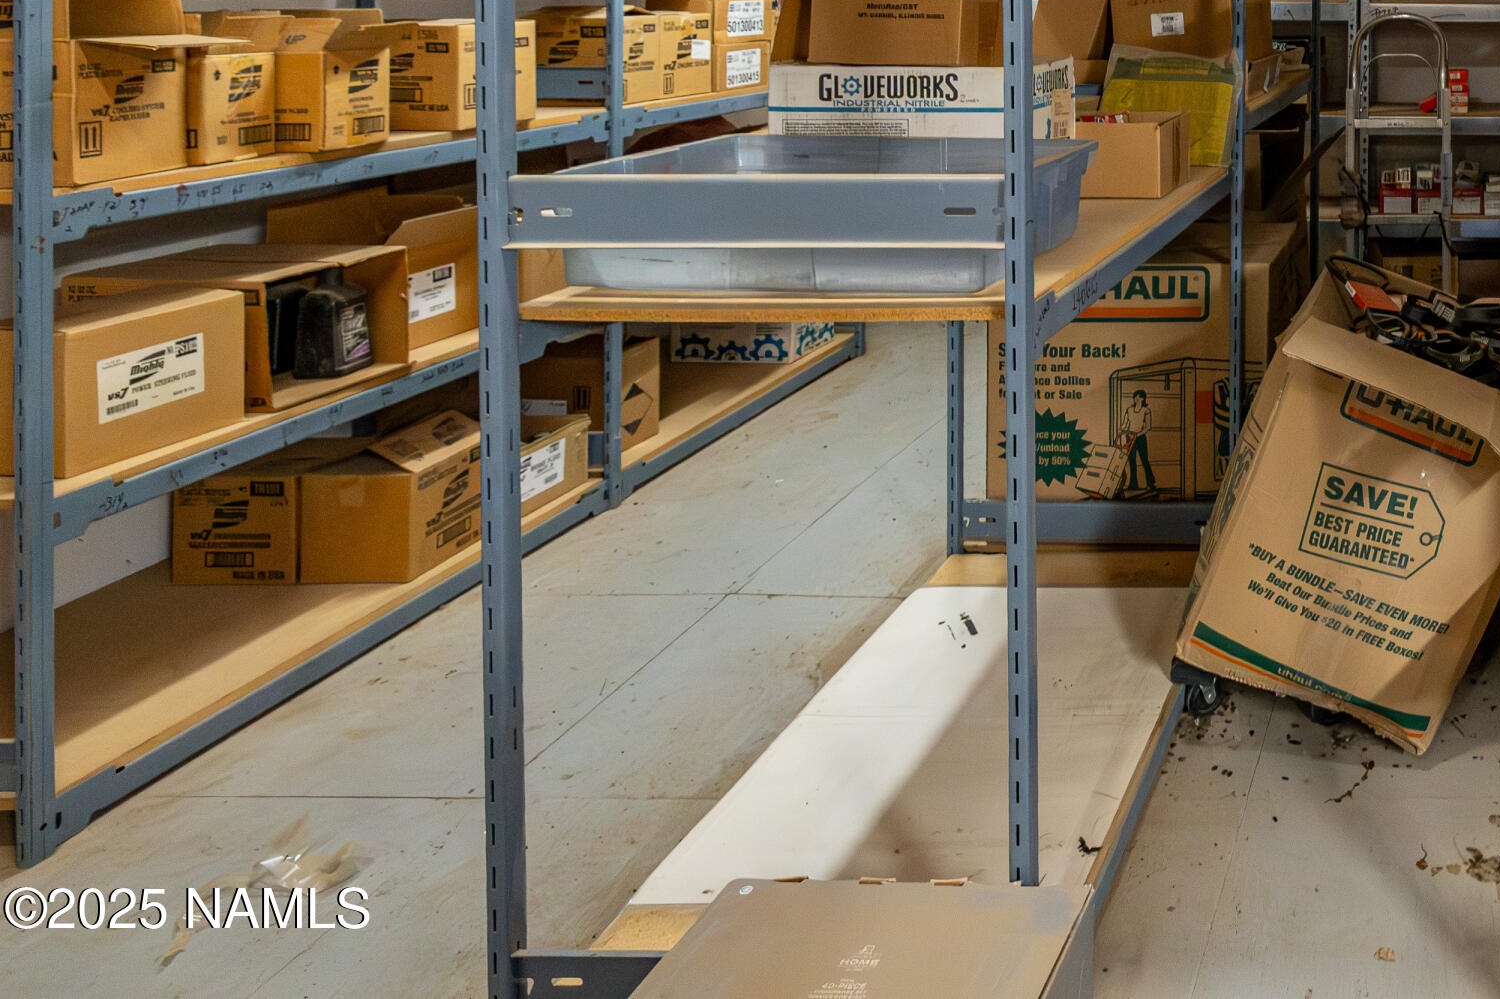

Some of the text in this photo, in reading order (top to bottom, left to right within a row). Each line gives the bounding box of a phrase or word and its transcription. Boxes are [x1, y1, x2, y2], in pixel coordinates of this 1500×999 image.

[818, 72, 959, 102] GLOVEWORKS
[832, 99, 945, 108] INDUSTRIAL NITRILE
[1042, 343, 1127, 358] Your Back!
[130, 357, 165, 377] Mighty
[1050, 361, 1071, 372] and
[131, 383, 152, 394] POWER
[1054, 375, 1091, 386] Dollies
[1058, 389, 1083, 400] Sale
[1323, 475, 1419, 519] SAVE!
[1313, 510, 1403, 547] BEST PRICE
[1265, 571, 1290, 592] Beat
[1292, 584, 1314, 601] Our
[1353, 611, 1390, 633] Prices
[1390, 626, 1414, 641] and
[1275, 558, 1287, 571] A
[1375, 601, 1409, 622] EVEN
[1409, 612, 1451, 636] MORE!
[1274, 594, 1299, 614] Give
[1300, 607, 1321, 624] You
[1354, 628, 1385, 650] FREE
[1385, 640, 1425, 662] Boxes!
